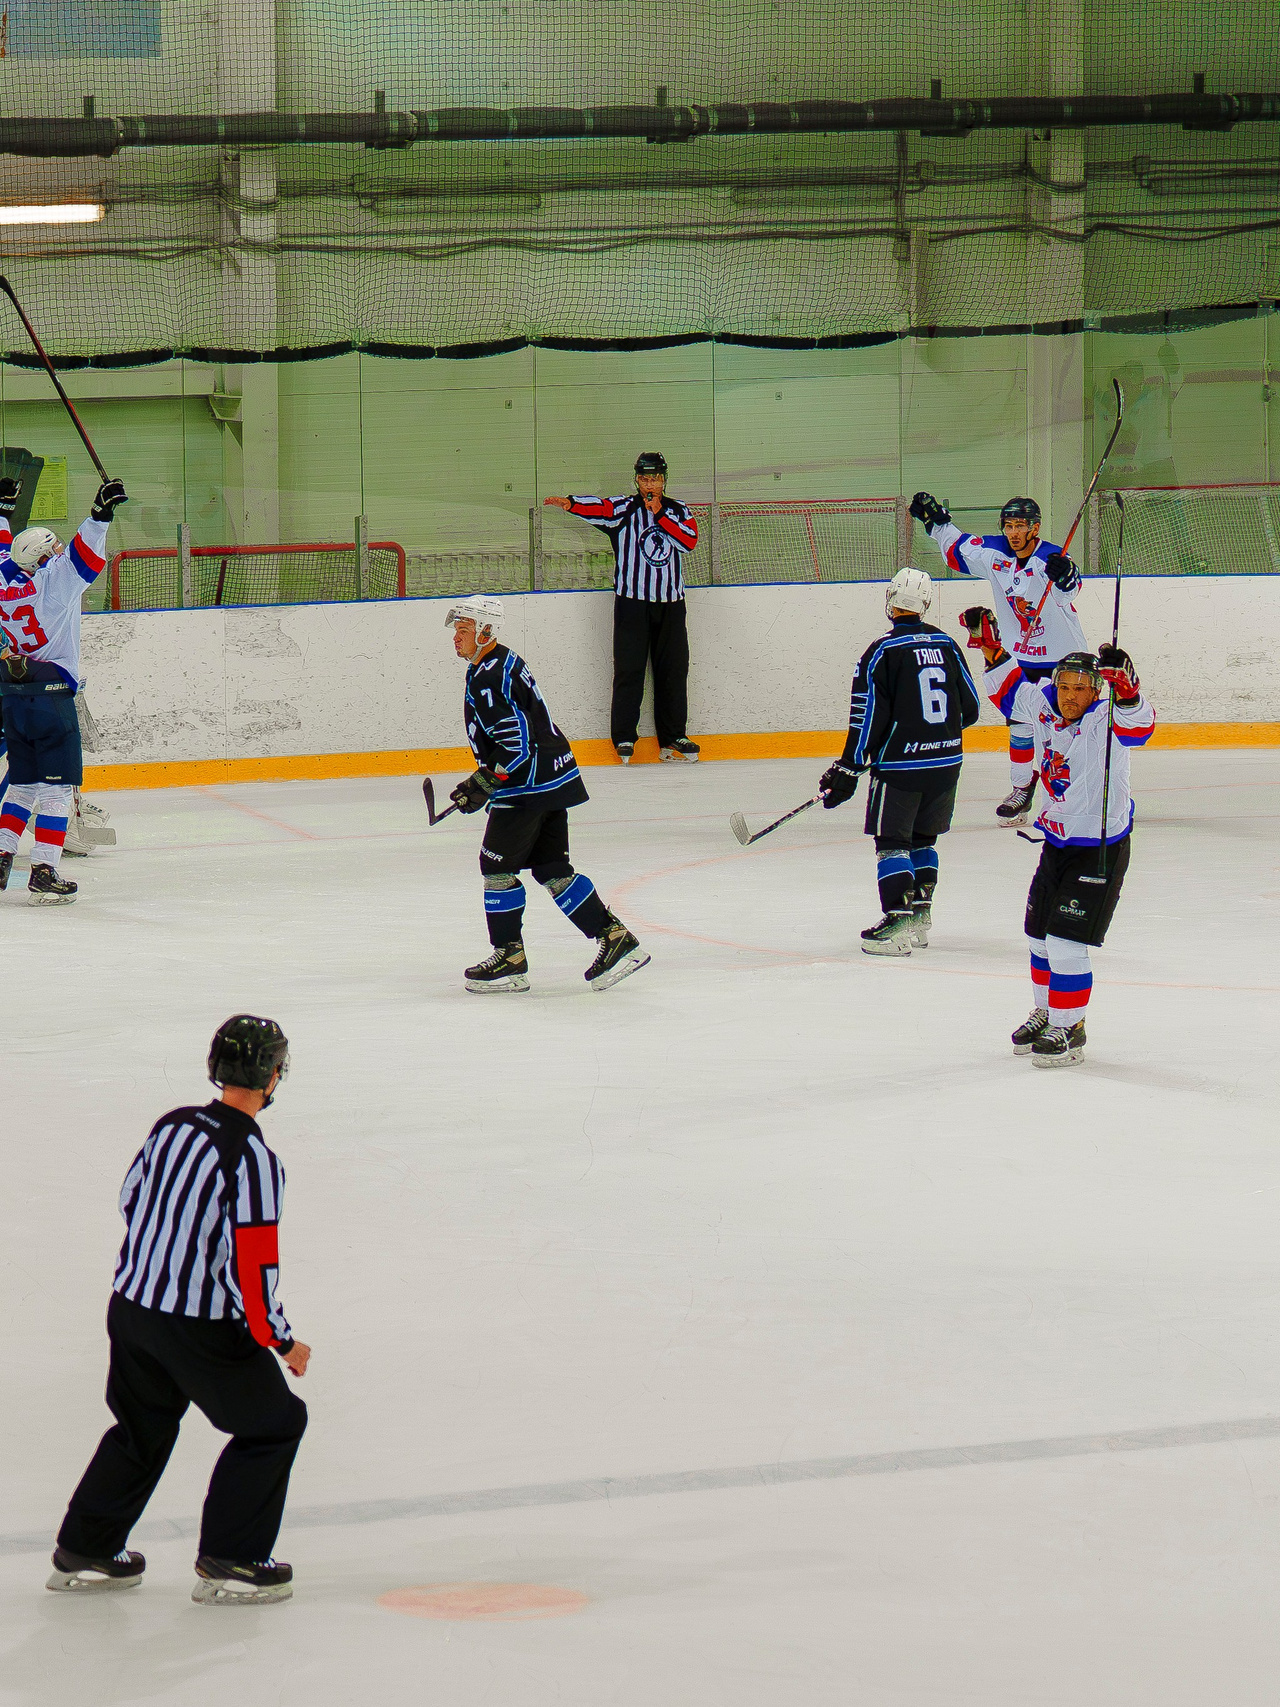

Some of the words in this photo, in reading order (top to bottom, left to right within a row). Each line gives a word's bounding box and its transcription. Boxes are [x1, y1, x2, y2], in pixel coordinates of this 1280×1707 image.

[480, 688, 494, 708] 7
[918, 667, 947, 724] 6
[920, 742, 941, 751] ONE
